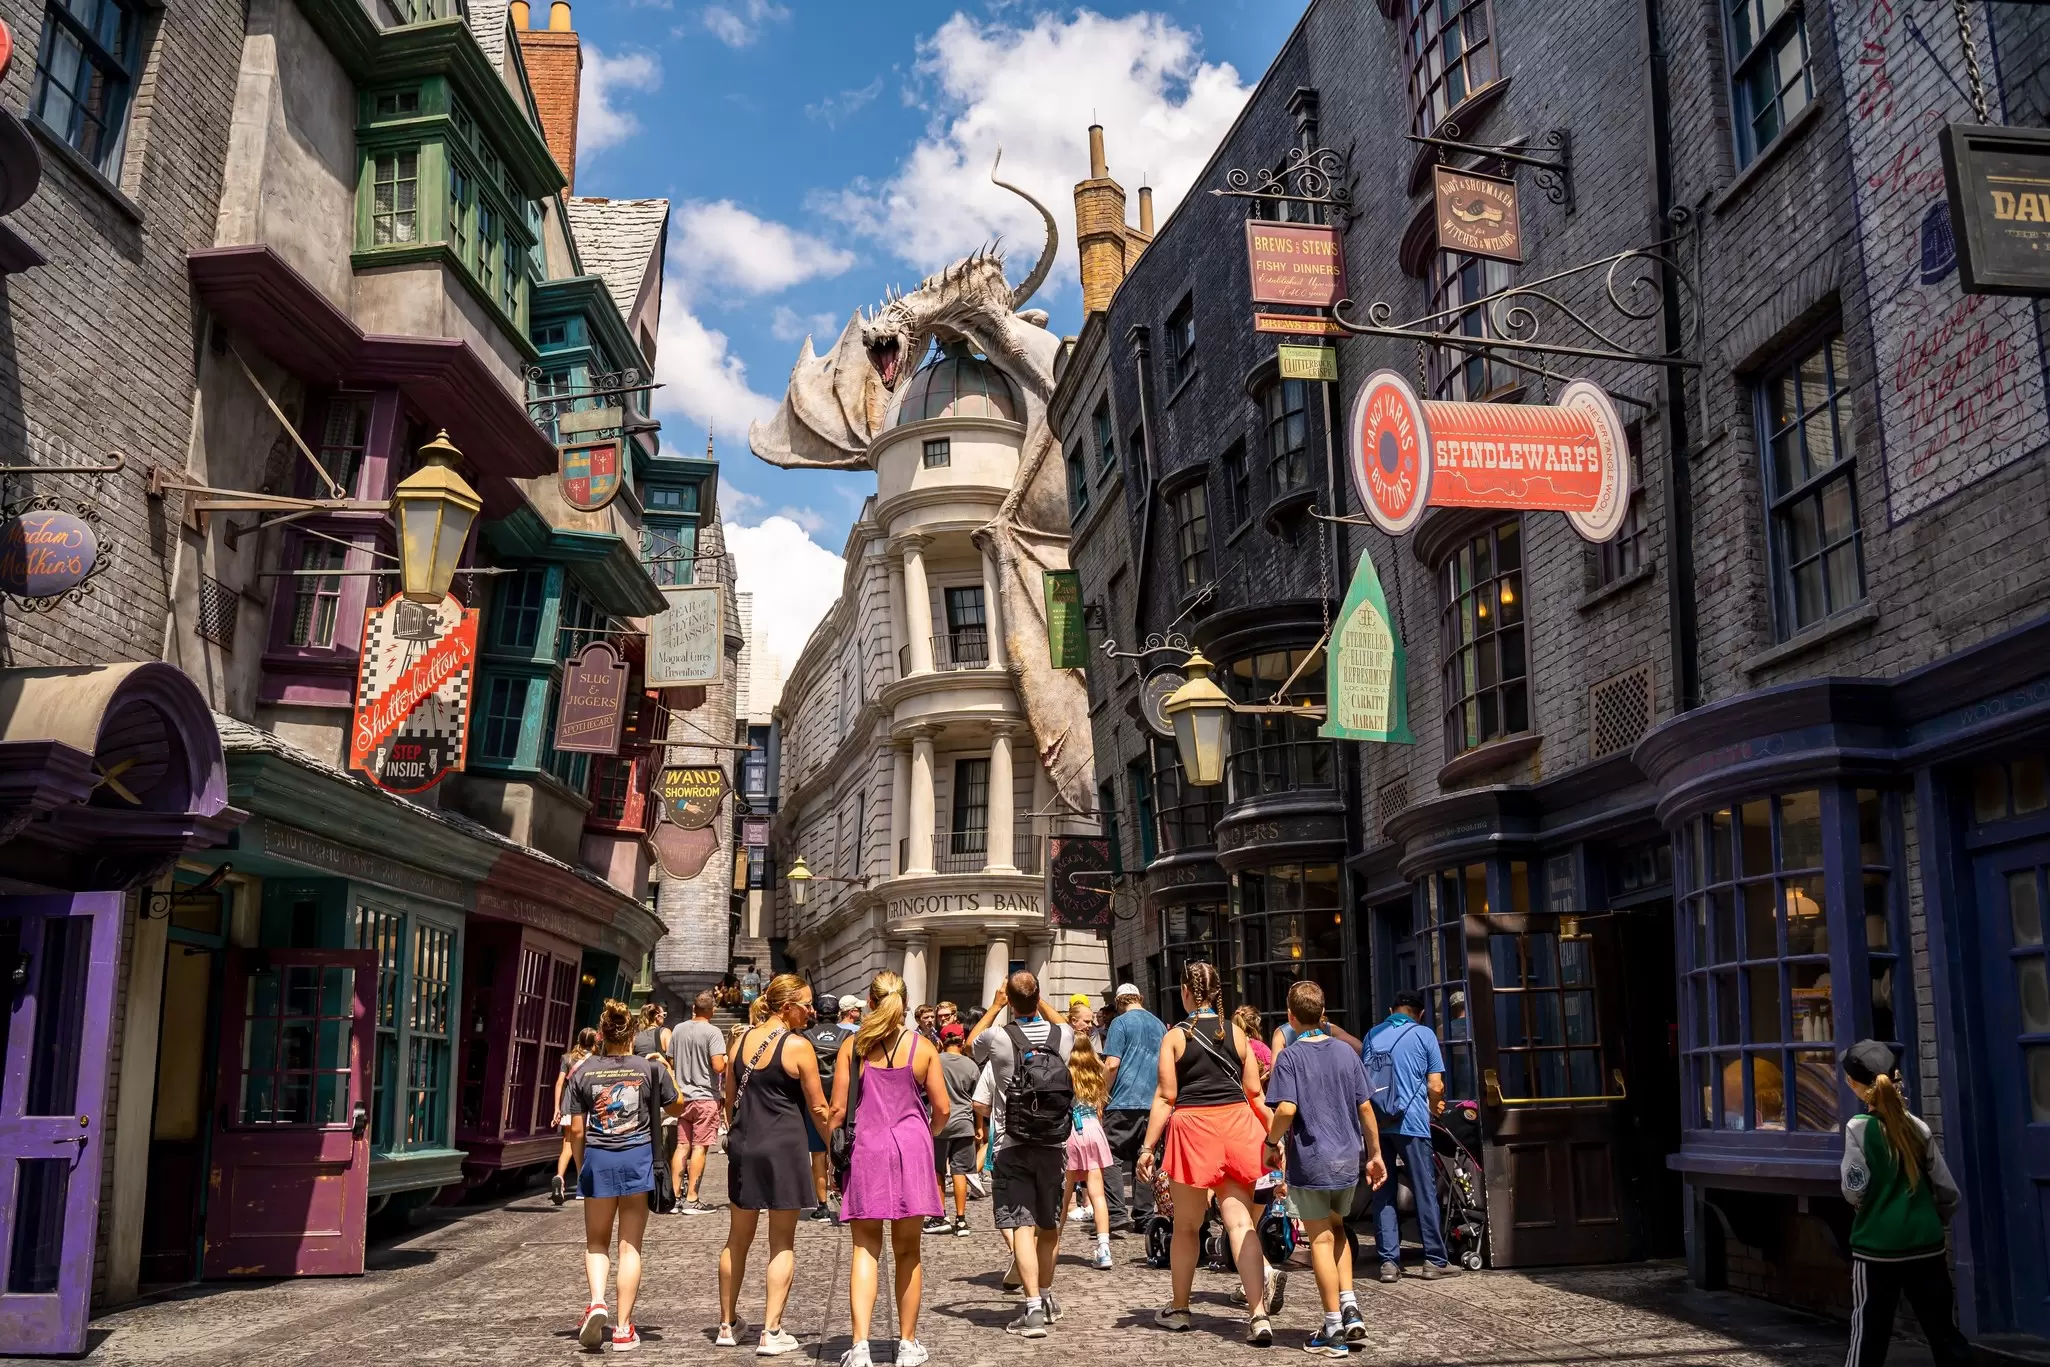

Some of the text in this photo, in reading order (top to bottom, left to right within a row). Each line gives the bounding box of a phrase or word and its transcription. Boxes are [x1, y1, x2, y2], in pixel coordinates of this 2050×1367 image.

[1440, 181, 1459, 196] BOOT
[1465, 179, 1514, 208] SHOEMAKER
[1443, 220, 1479, 248] WITCHES
[1484, 230, 1516, 251] WIZARDS
[1254, 236, 1293, 253] BREWS
[1302, 240, 1338, 256] STEWS
[1256, 260, 1340, 276] FISHY DINNERS
[1260, 318, 1301, 329] BREWS
[1308, 321, 1343, 332] STEW
[1284, 358, 1332, 373] CLUTTERBUCK
[1367, 393, 1414, 451] FANCY YARNS
[1436, 440, 1599, 473] SPINDLEWARPS
[1585, 403, 1614, 514] NEVER-TANGLE WOOL
[1371, 467, 1412, 510] BUTTONS
[6, 517, 83, 548] Madam
[668, 601, 696, 621] FEAR
[668, 610, 708, 636] FLYING
[1346, 630, 1388, 651] ETERNELLE'S
[658, 650, 712, 664] Magical Cures
[1350, 649, 1384, 668] ELIXIR OF
[580, 674, 610, 684] SLUG
[664, 666, 706, 678] Preventions
[356, 637, 470, 752] Shutterbutton's
[588, 684, 600, 695] &
[567, 696, 616, 708] JIGGERS
[1352, 694, 1384, 711] CARKITT
[1960, 682, 2050, 727] WOOL SHO
[562, 715, 614, 736] APOTHECARY
[1352, 714, 1384, 730] MARKET
[392, 744, 422, 761] STEP
[386, 762, 426, 778] INSIDE
[666, 770, 721, 784] WAND
[665, 786, 720, 798] SHOWROOM
[888, 892, 1040, 920] GRINGOTTS BANK
